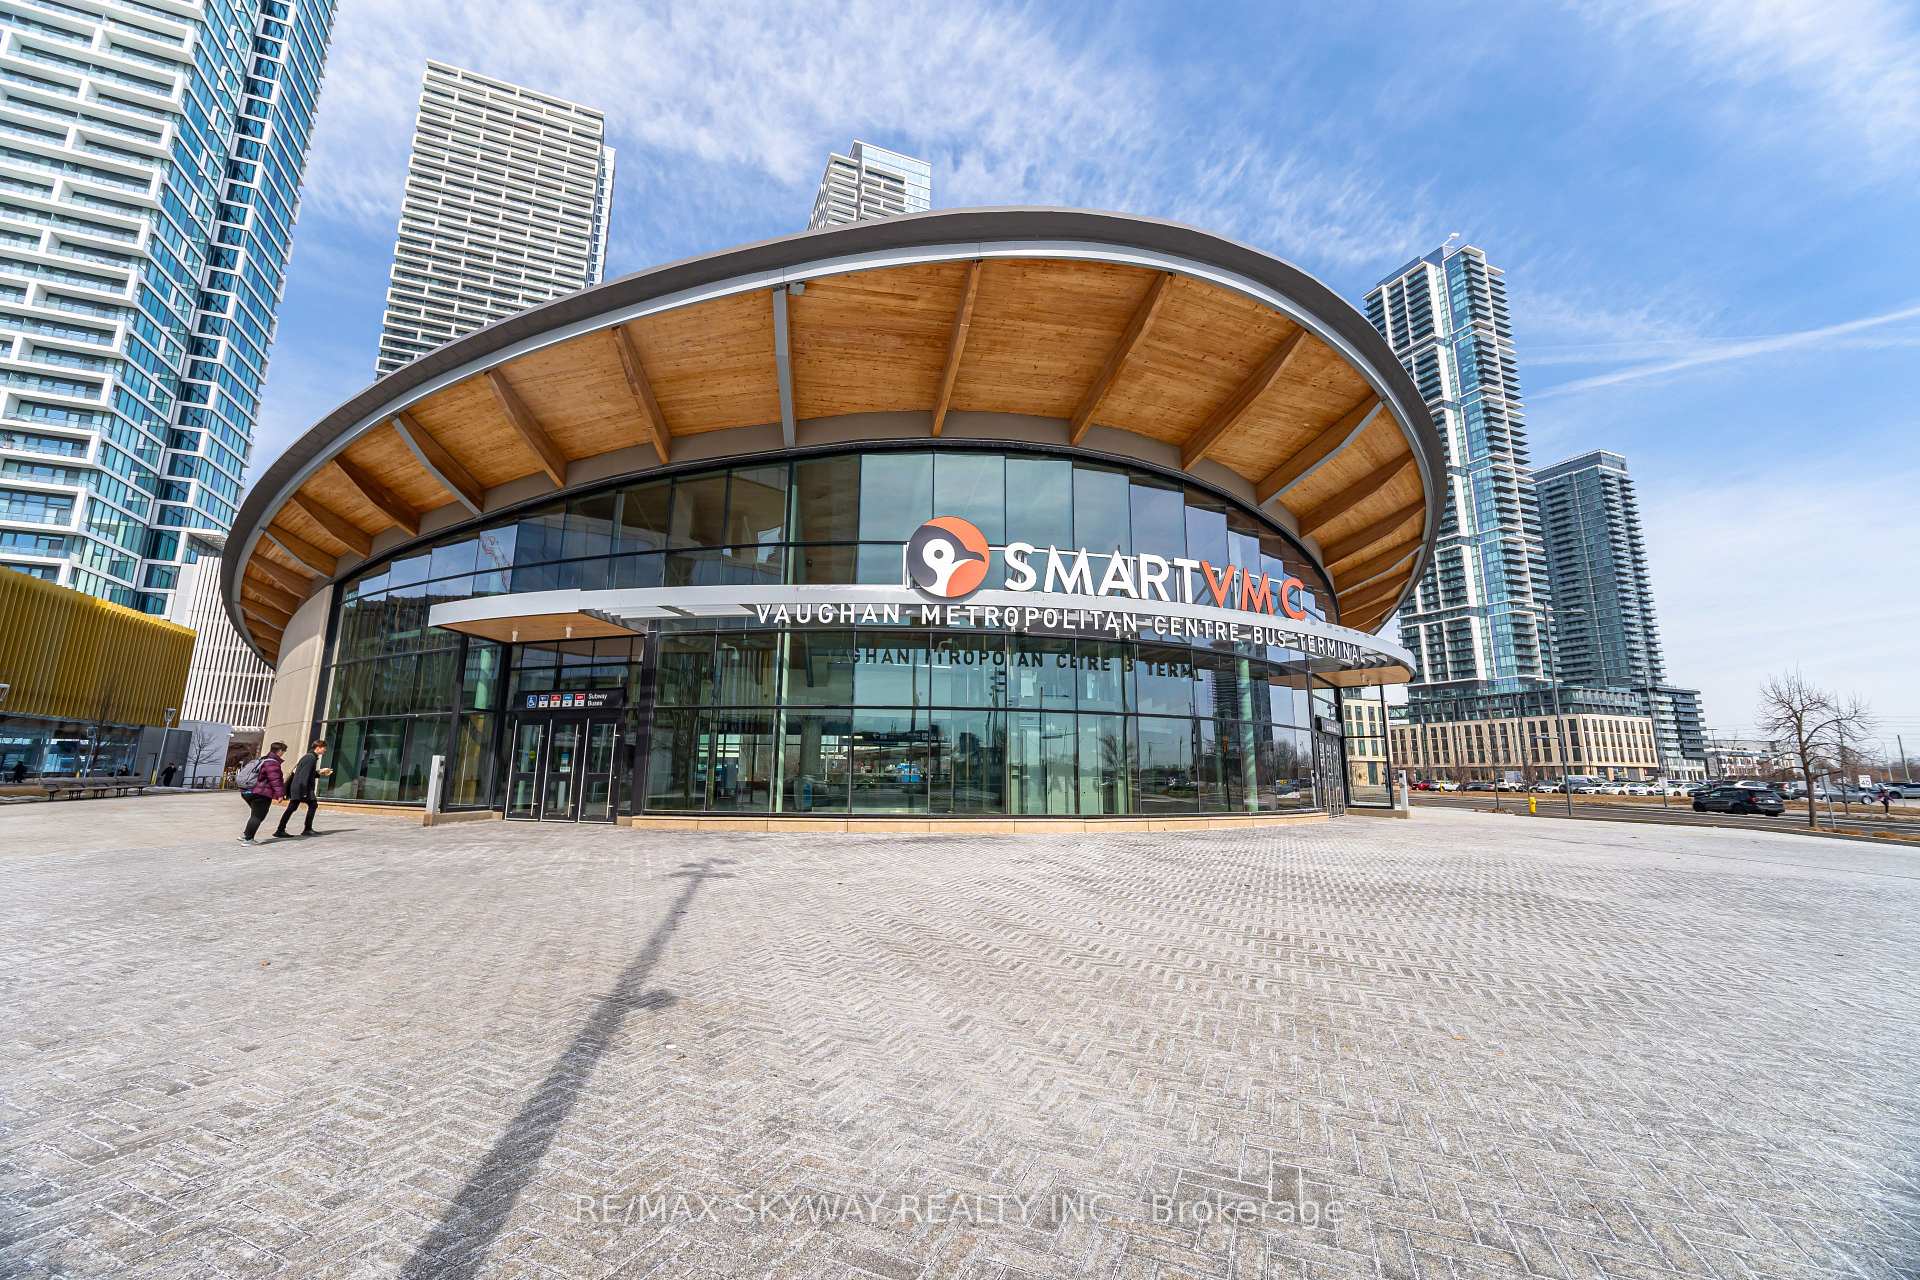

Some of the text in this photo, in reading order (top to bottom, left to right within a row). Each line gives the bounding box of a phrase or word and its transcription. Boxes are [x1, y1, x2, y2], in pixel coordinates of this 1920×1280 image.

[756, 603, 1366, 664] VAUGHAN METROPOLITAN CENTRE BUS TERMINAL
